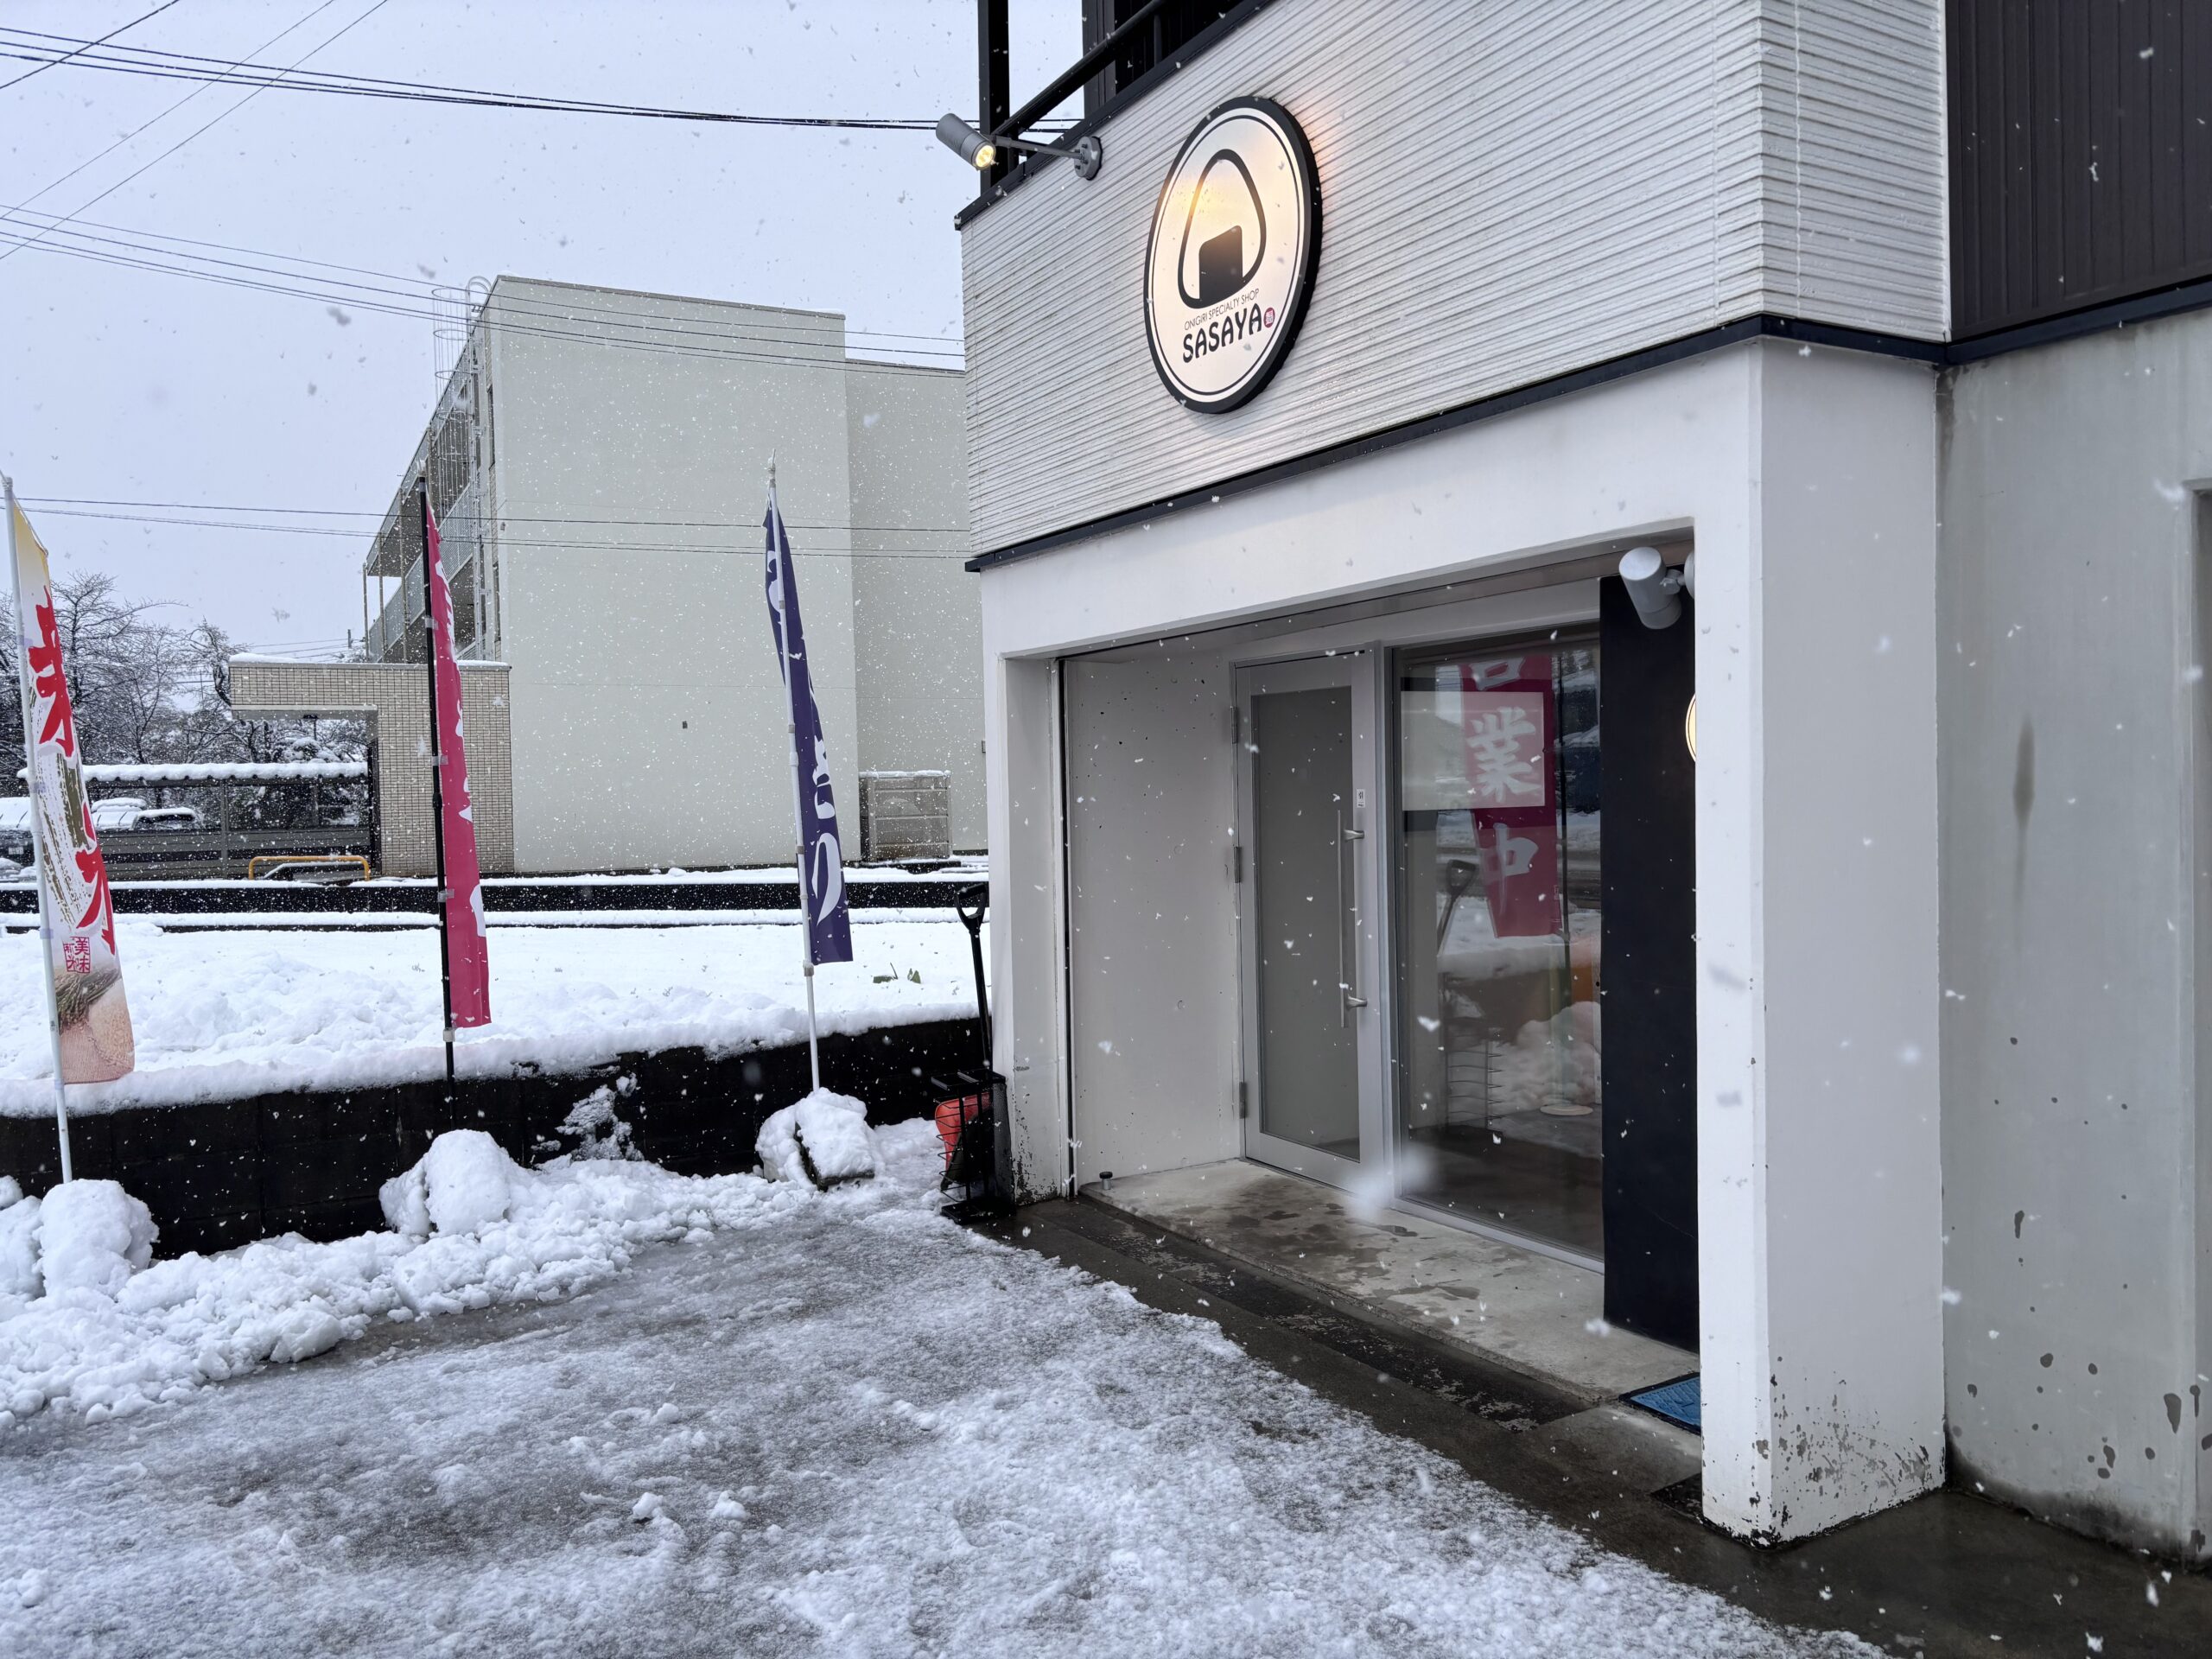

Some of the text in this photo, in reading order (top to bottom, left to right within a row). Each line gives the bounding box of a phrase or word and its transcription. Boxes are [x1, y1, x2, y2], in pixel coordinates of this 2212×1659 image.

[1182, 302, 1262, 363] SASAYA
[1184, 288, 1260, 331] ONIGIRI SPECIALTY SHOP
